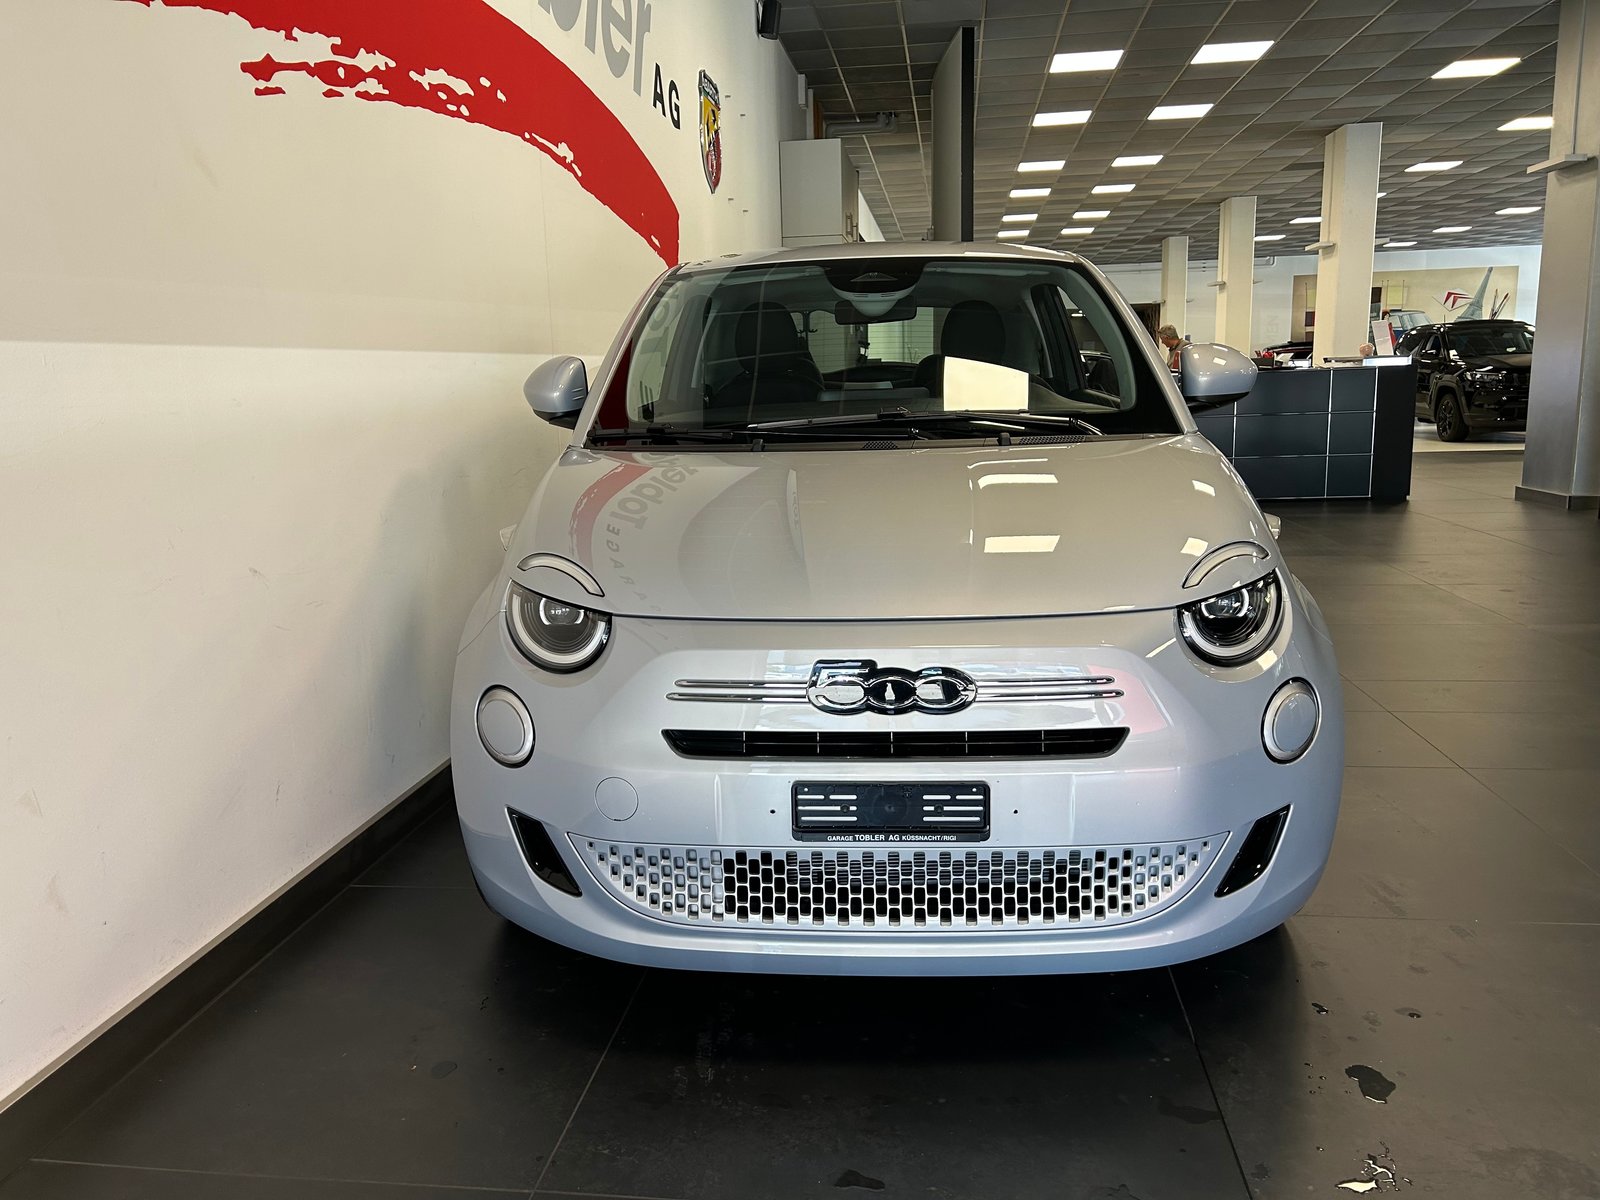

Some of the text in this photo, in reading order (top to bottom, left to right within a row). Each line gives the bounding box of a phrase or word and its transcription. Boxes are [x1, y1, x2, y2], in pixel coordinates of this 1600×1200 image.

[538, 0, 681, 130] er AG
[806, 659, 978, 715] 500
